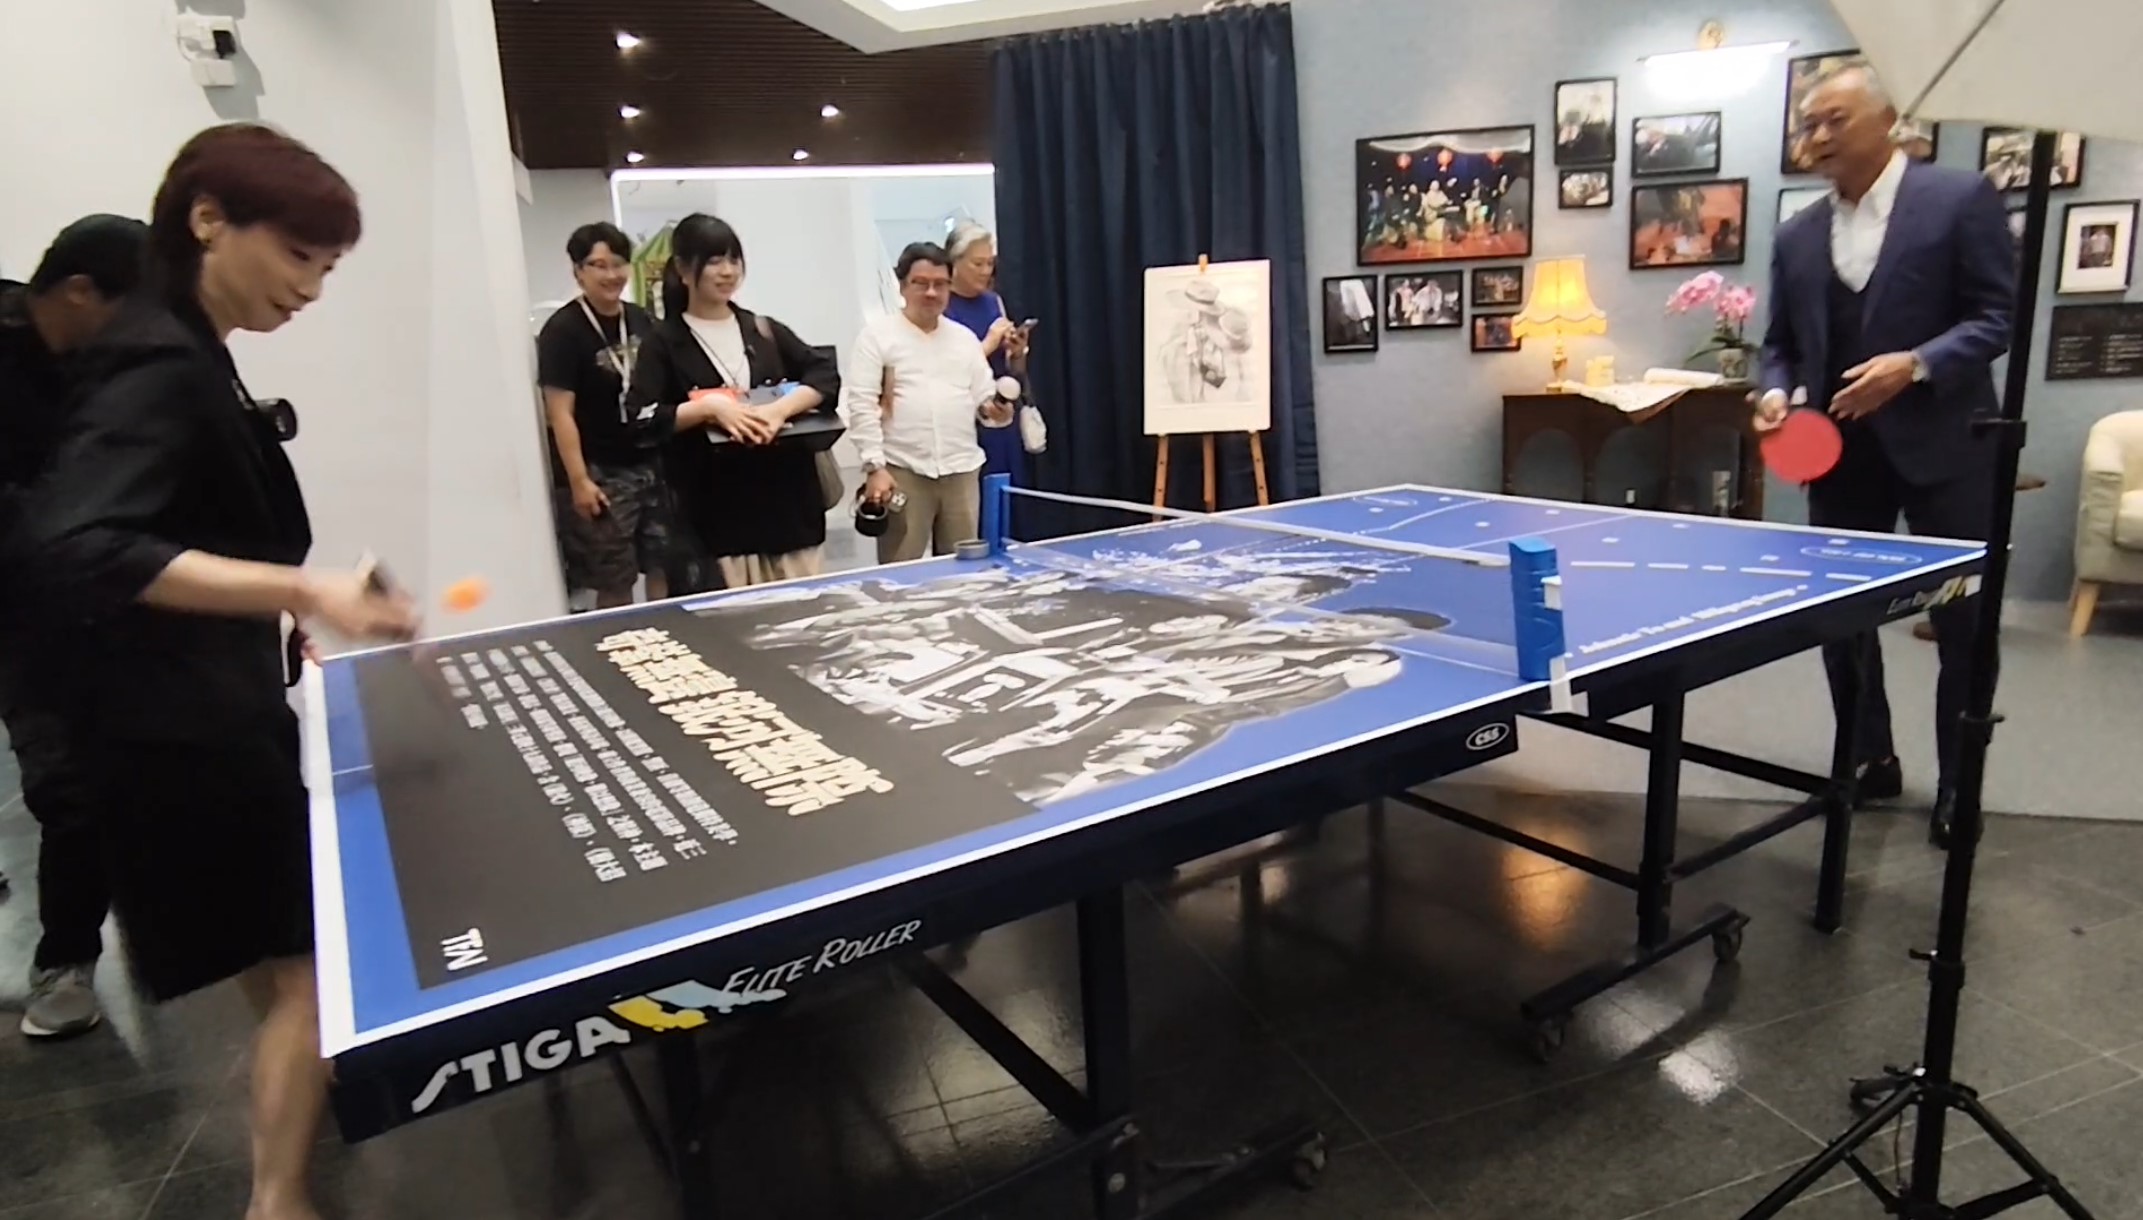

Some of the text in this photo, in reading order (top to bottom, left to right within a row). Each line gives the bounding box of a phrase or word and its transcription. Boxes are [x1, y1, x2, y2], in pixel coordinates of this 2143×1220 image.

[658, 690, 894, 816] 銀河無際
[411, 1015, 631, 1114] STIGA
